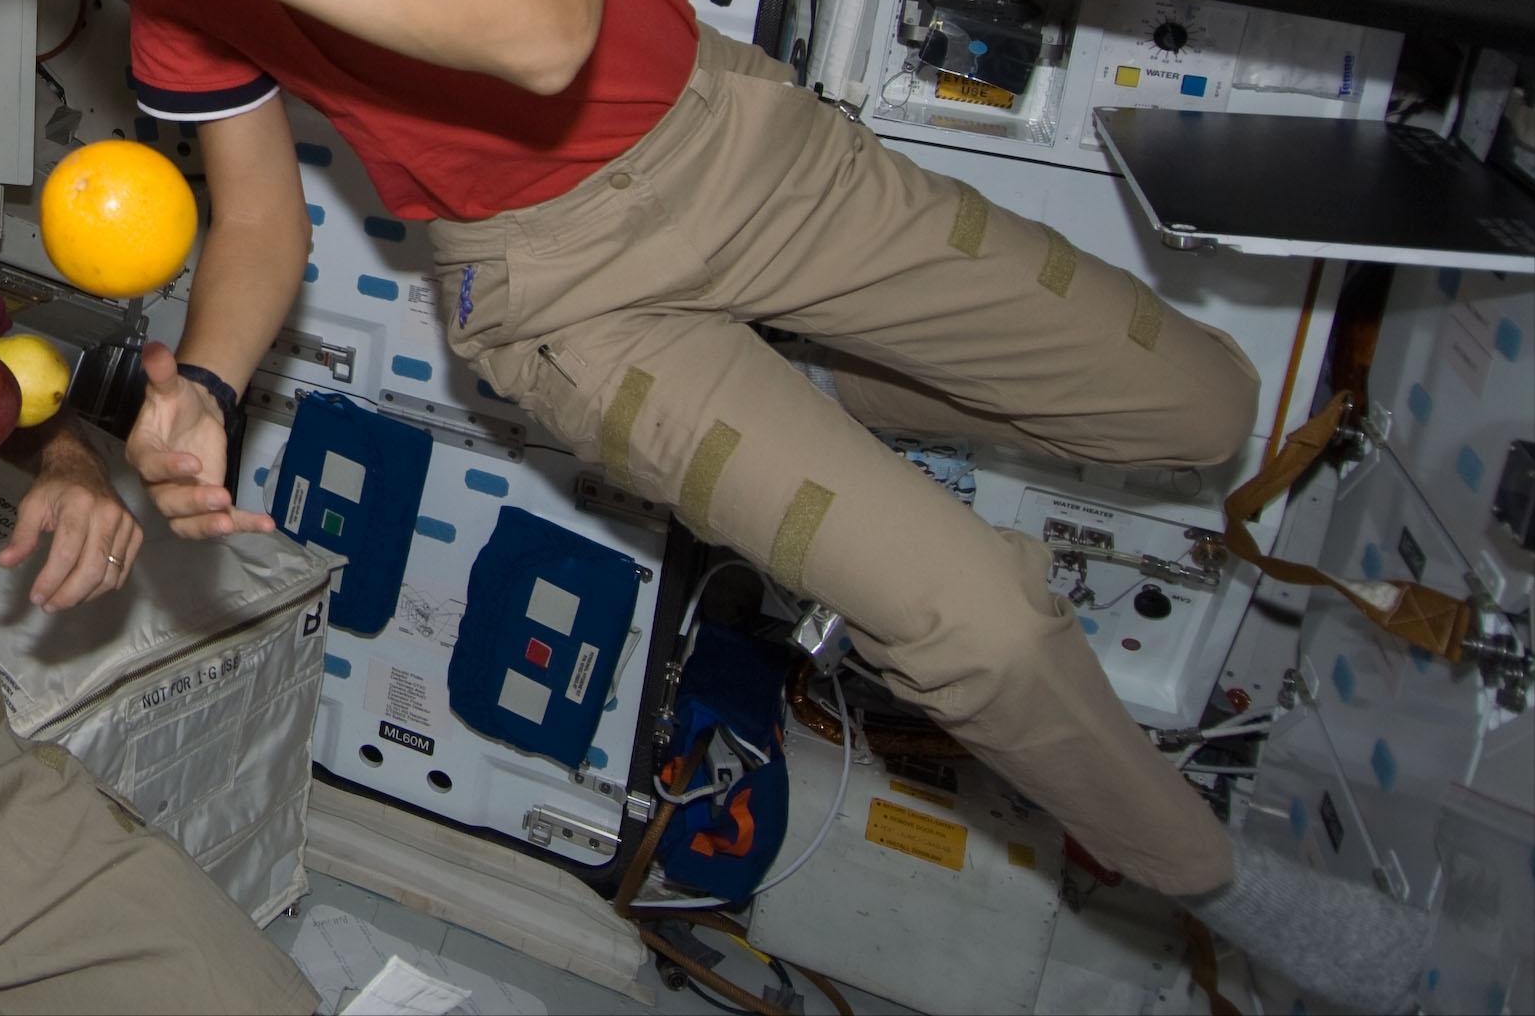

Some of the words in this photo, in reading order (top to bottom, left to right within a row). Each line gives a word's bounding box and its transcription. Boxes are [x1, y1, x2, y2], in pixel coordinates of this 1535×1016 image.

[1146, 69, 1181, 80] WATER
[961, 86, 989, 98] USE
[1053, 500, 1081, 512] WATER
[1082, 506, 1114, 519] HEATER
[142, 686, 167, 709] NOT
[171, 676, 191, 697] FOR
[383, 725, 430, 751] ML60M
